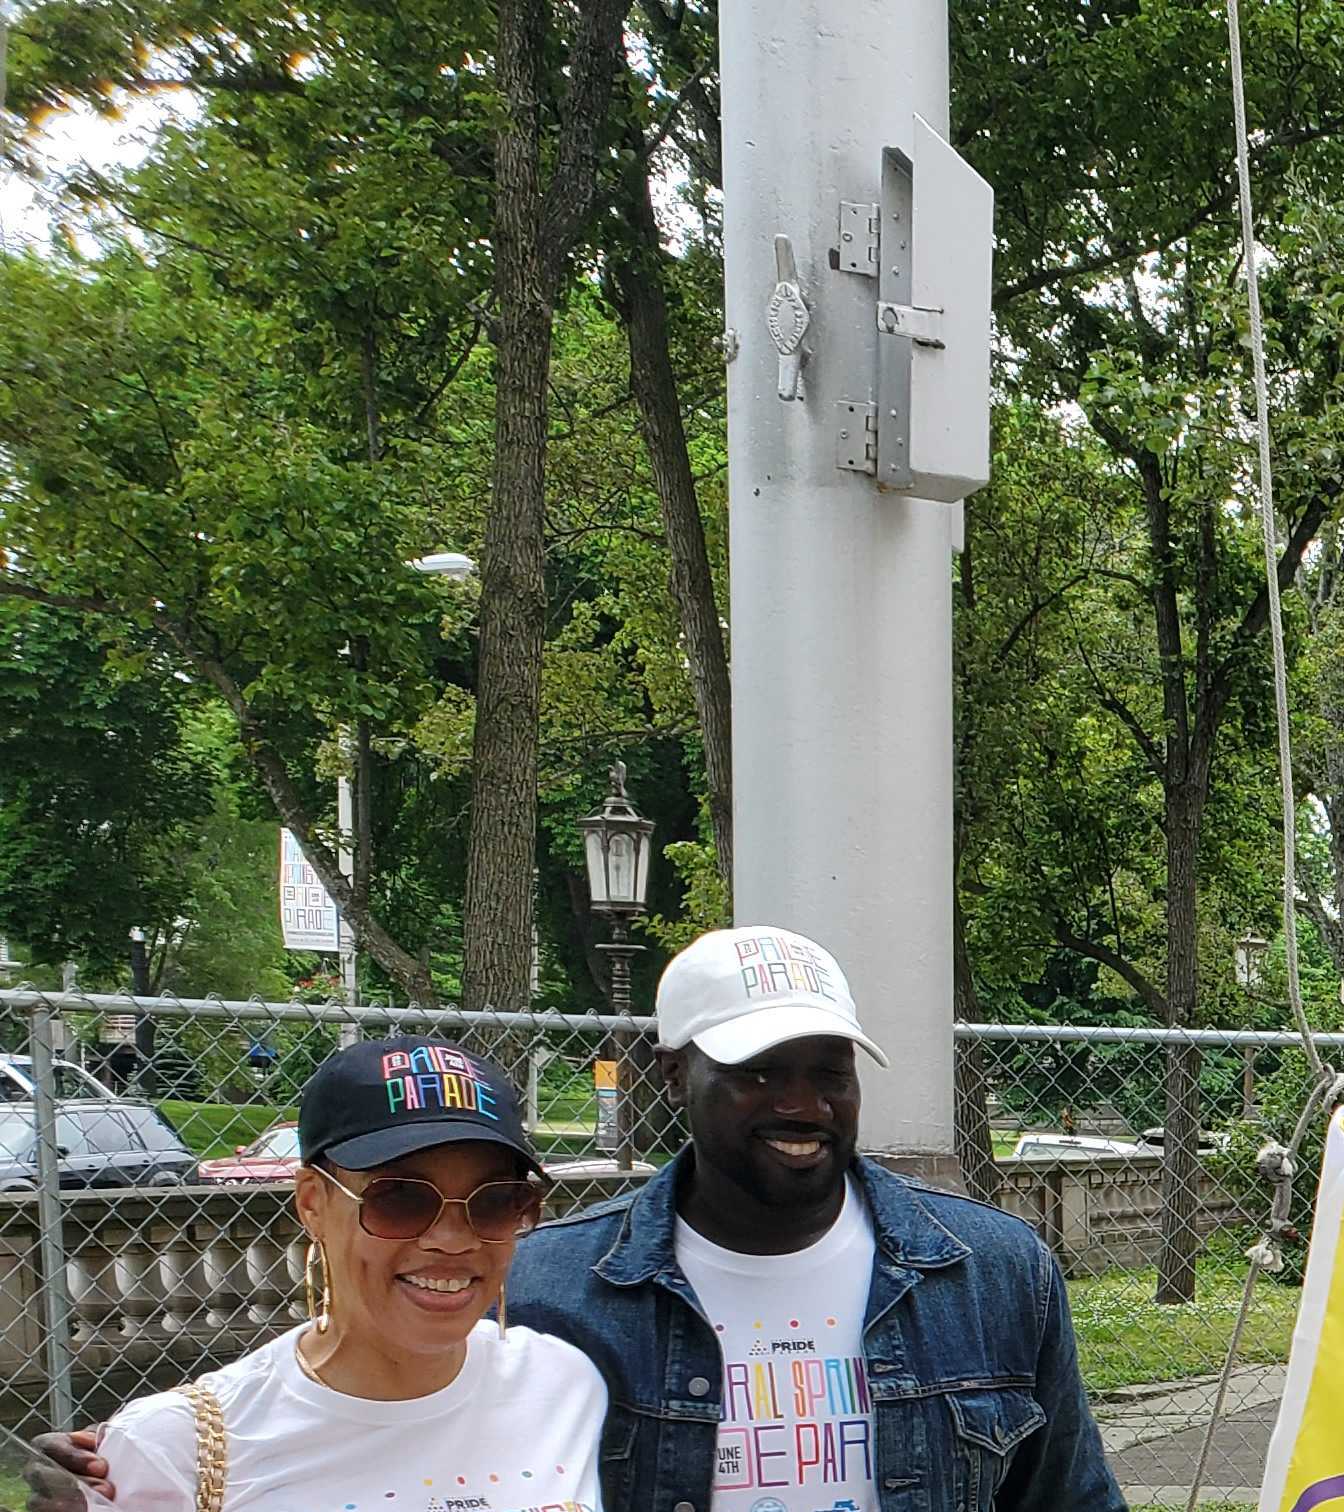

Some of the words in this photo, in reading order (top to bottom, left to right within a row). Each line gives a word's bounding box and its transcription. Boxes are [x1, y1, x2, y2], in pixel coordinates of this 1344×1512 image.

[742, 963, 836, 1001] PARADE
[382, 1046, 490, 1086] PRIDE
[386, 1073, 498, 1120] PARADE
[771, 1340, 816, 1351] PRIDE
[718, 1461, 740, 1474] 4TH
[446, 1497, 489, 1511] PRIDE
